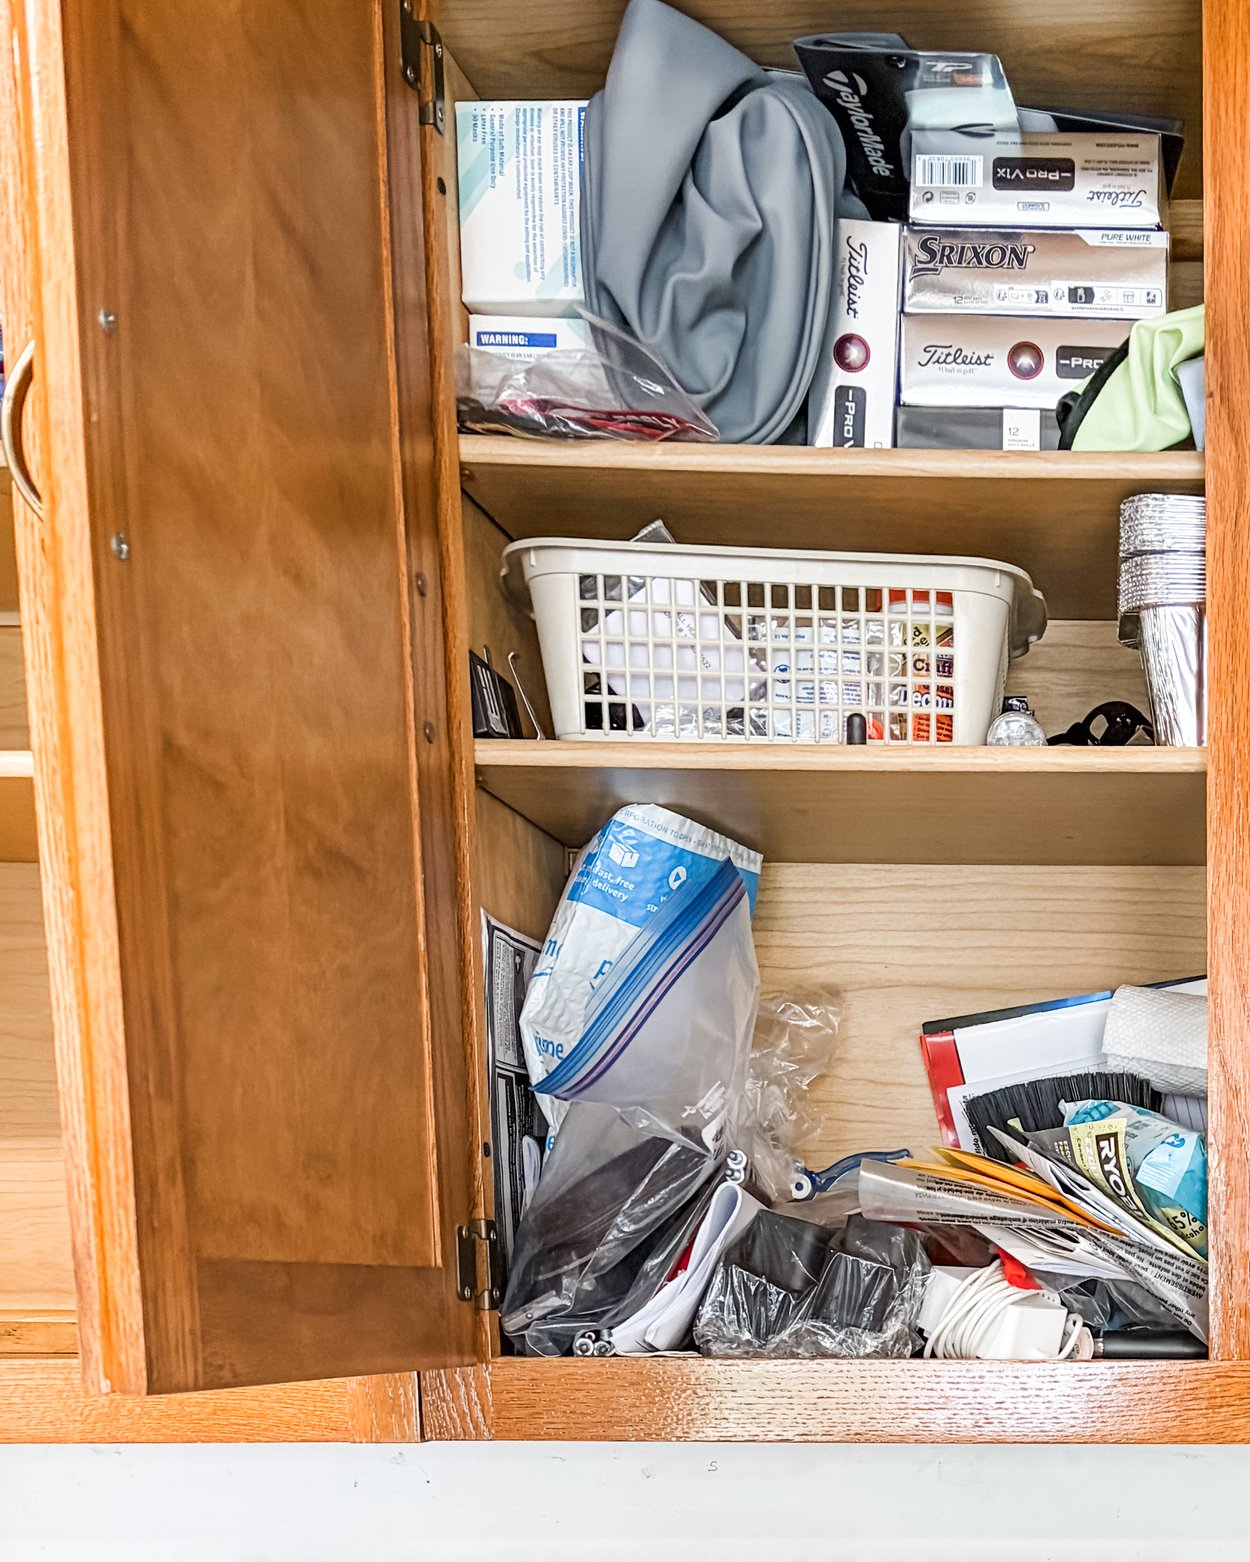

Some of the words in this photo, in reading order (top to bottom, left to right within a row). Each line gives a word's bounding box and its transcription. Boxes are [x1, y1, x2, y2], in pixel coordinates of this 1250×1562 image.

[822, 70, 892, 178] TaylorMade
[1087, 190, 1147, 208] Titleist
[1101, 233, 1124, 241] PURE
[1126, 234, 1151, 242] WHITE
[916, 236, 1029, 269] SRIXON
[846, 236, 868, 318] Titleist
[481, 334, 528, 345] WARNING:
[918, 344, 994, 367] Titleist
[1008, 427, 1019, 436] 12
[592, 880, 629, 902] delivery
